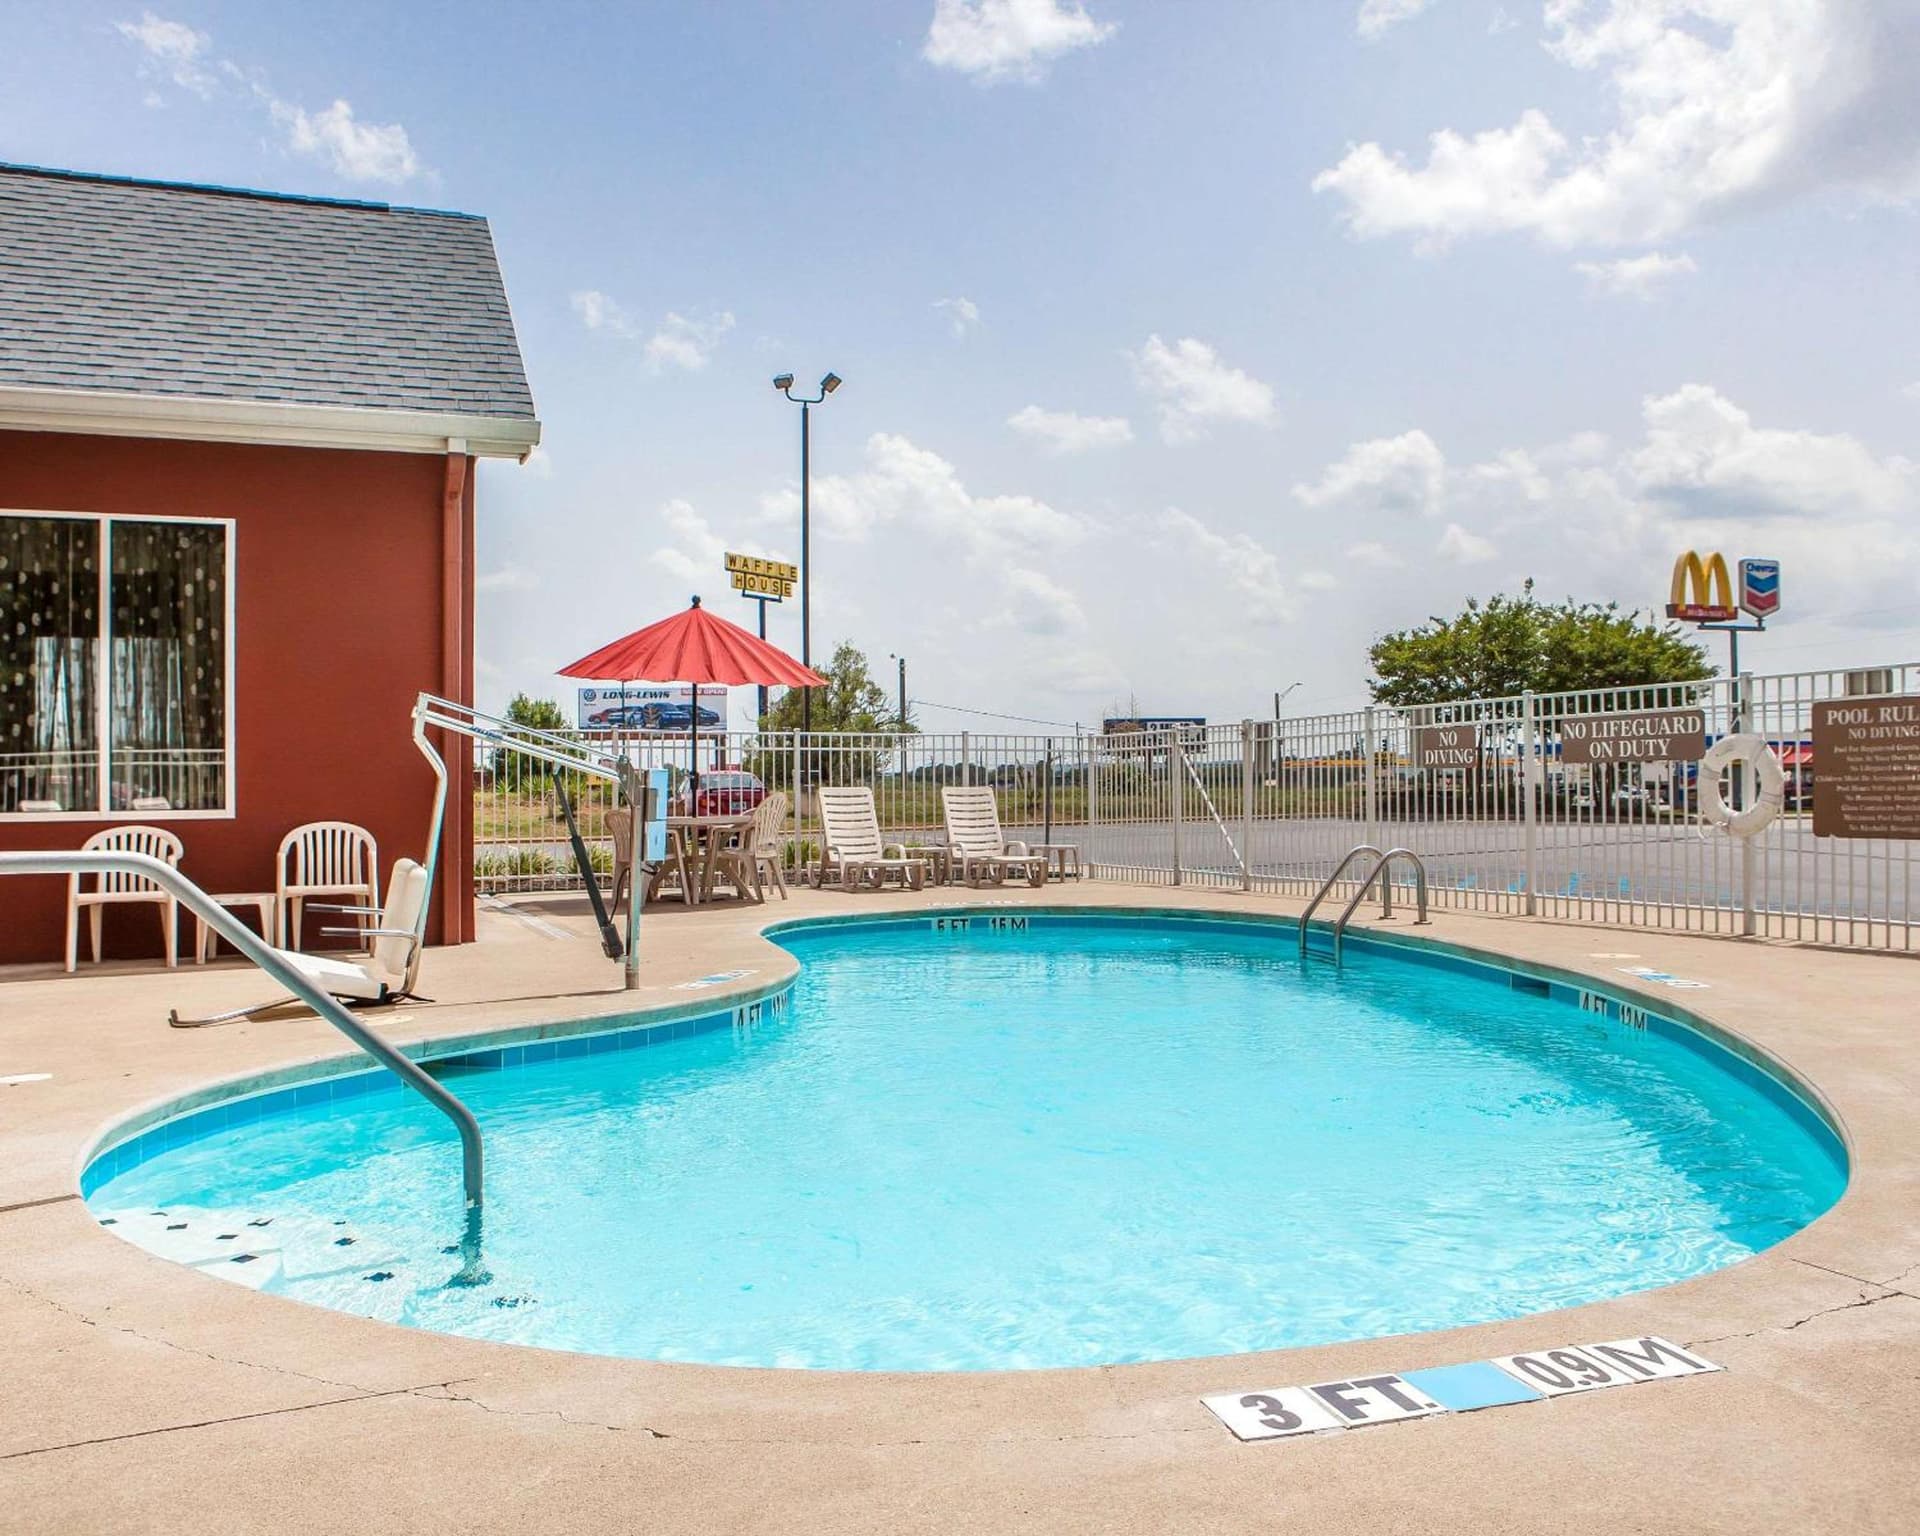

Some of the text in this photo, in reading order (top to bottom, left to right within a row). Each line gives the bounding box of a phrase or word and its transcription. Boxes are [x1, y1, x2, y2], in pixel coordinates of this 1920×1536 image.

[728, 554, 797, 578] WAFFLE
[735, 574, 792, 594] HOUSE
[1826, 708, 1873, 726] POOL
[1563, 715, 1701, 740] NO LIFEGUARD
[1848, 725, 1920, 740] NO DIVING
[1439, 730, 1458, 747] NO
[1589, 738, 1672, 759] ON DUTY
[1425, 748, 1474, 765] DIVING
[1239, 1394, 1302, 1431] 3
